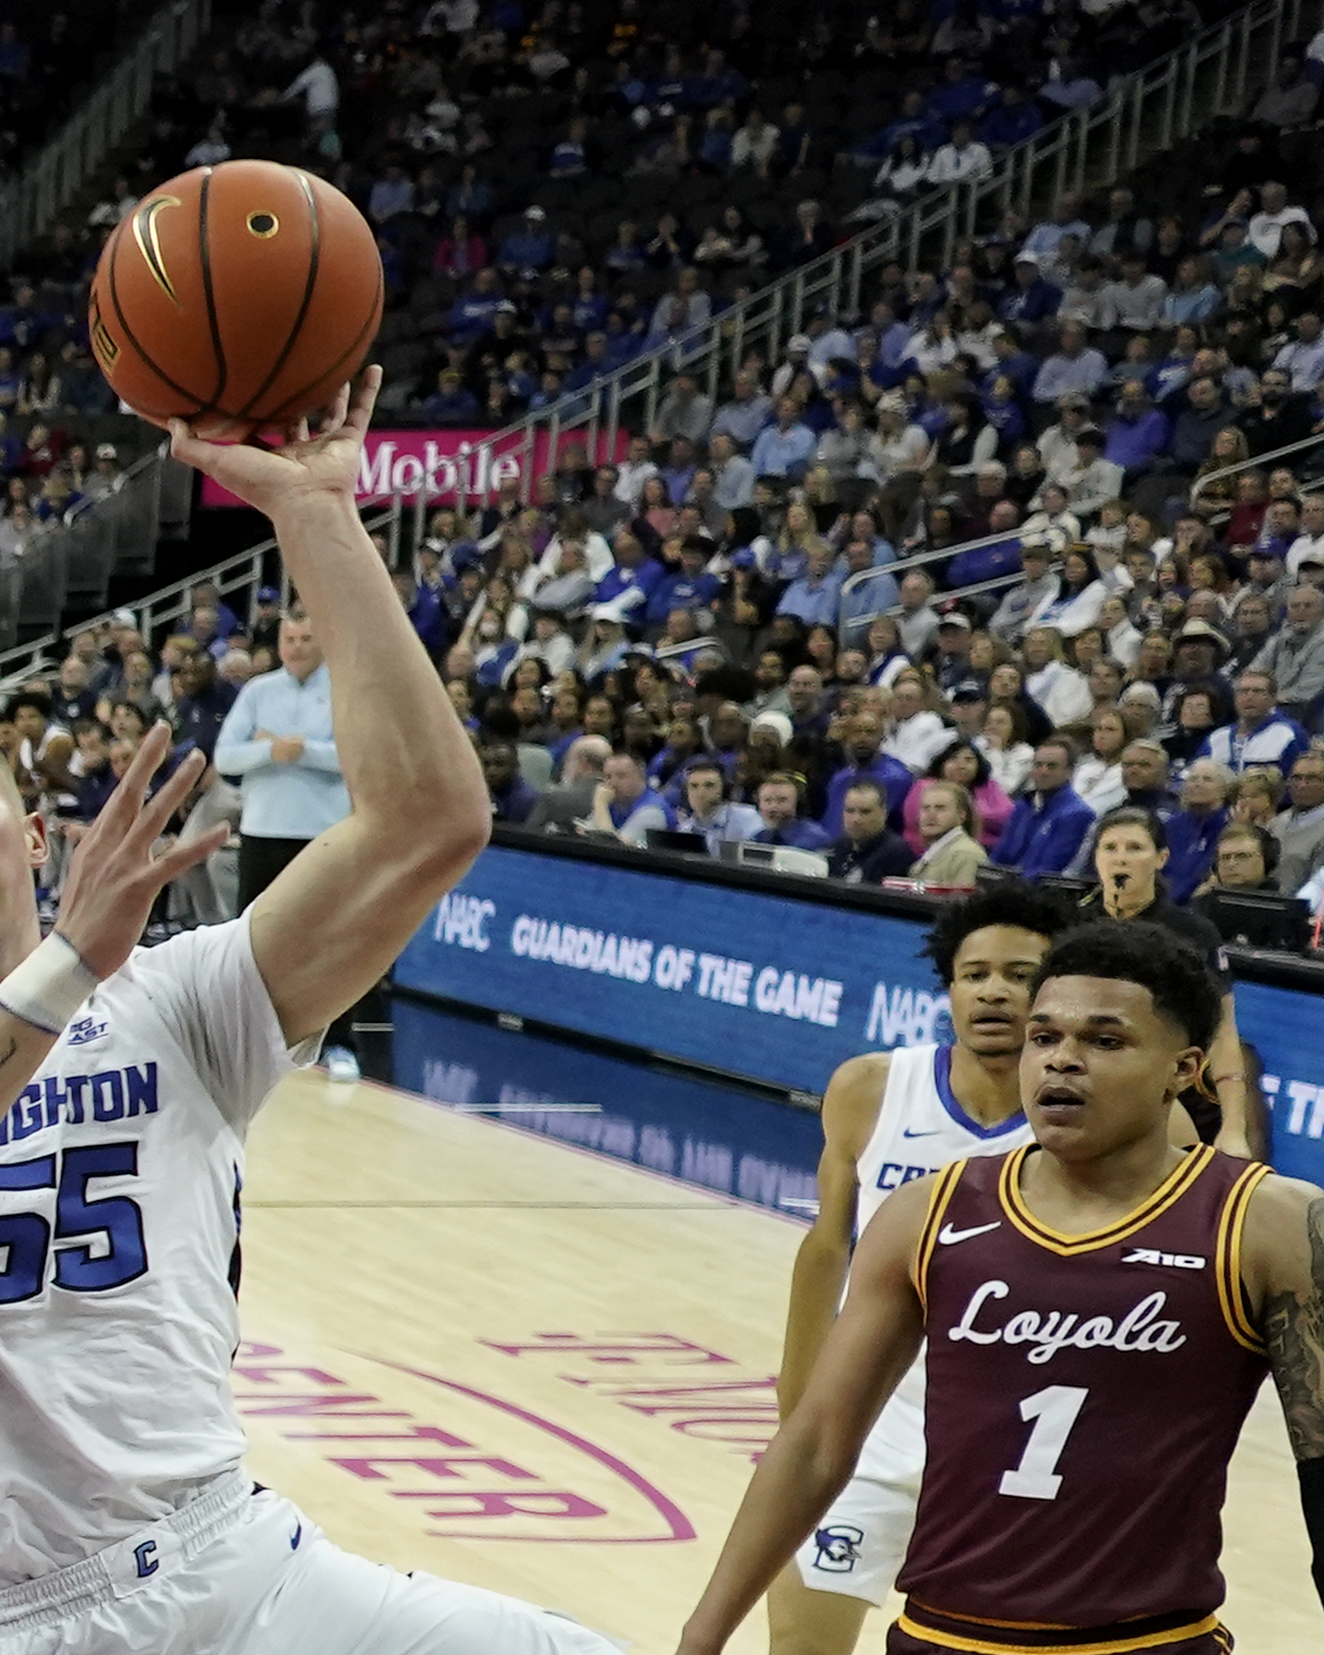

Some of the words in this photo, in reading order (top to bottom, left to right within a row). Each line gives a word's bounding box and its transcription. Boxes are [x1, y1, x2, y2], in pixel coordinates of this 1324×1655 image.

[434, 892, 497, 952] NABC
[512, 914, 655, 984] GUARDIANS
[655, 944, 696, 991] OF
[697, 953, 754, 1007] THE
[754, 966, 844, 1027] GAME
[1121, 1248, 1206, 1270] A10
[948, 1280, 1187, 1365] Loyola
[998, 1385, 1090, 1500] 1
[133, 1540, 160, 1578] C
